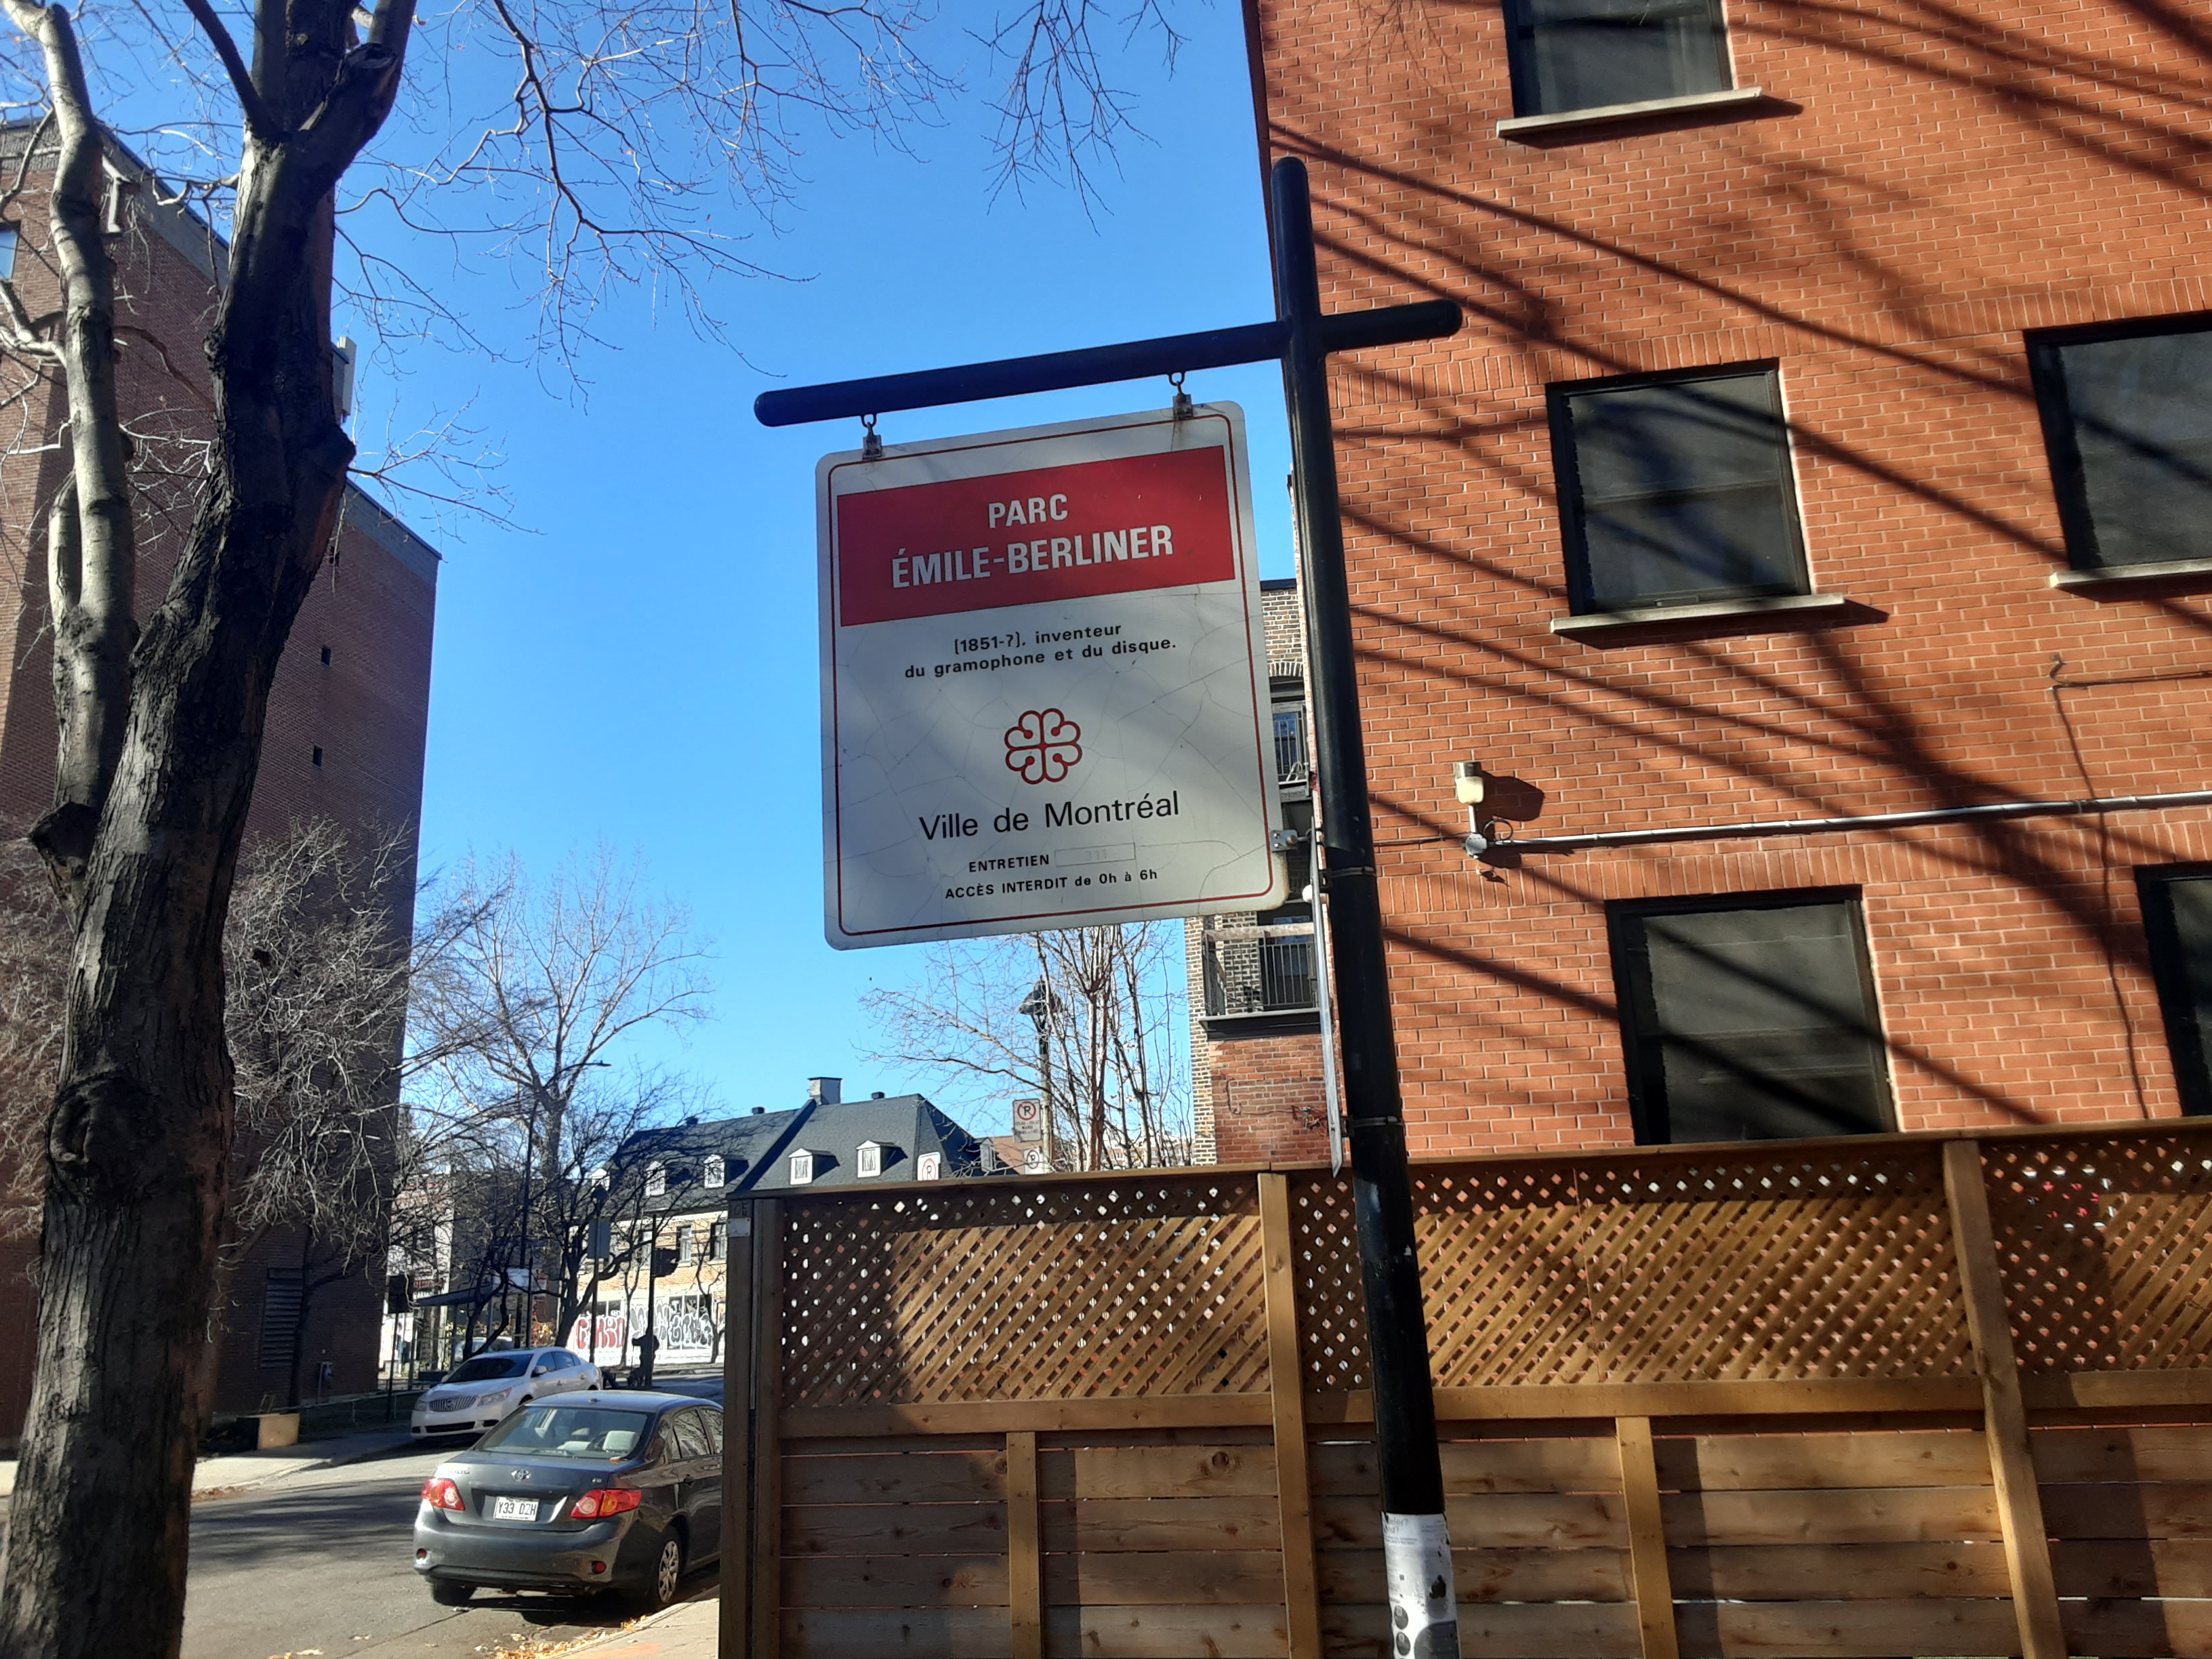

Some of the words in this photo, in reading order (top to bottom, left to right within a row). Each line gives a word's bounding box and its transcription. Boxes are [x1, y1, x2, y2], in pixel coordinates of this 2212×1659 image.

[989, 493, 1068, 529] PARC
[892, 525, 1174, 589] ÉMILE-BERLINER
[1035, 625, 1122, 644] inventeur
[905, 664, 925, 678] du
[934, 653, 1045, 678] gramophone
[1054, 648, 1073, 661] et
[1082, 644, 1103, 658] du
[1111, 639, 1176, 655] disque.
[918, 813, 979, 840] Ville
[993, 807, 1029, 833] de
[1045, 790, 1179, 828] Montréal
[968, 854, 1049, 873] ENTRETIEN
[945, 882, 994, 899] ACCÈS
[1002, 876, 1068, 894] INTERDIT
[1074, 876, 1091, 887] de
[1124, 872, 1132, 882] à
[1139, 869, 1158, 880] 6h
[498, 1502, 515, 1514] Y33
